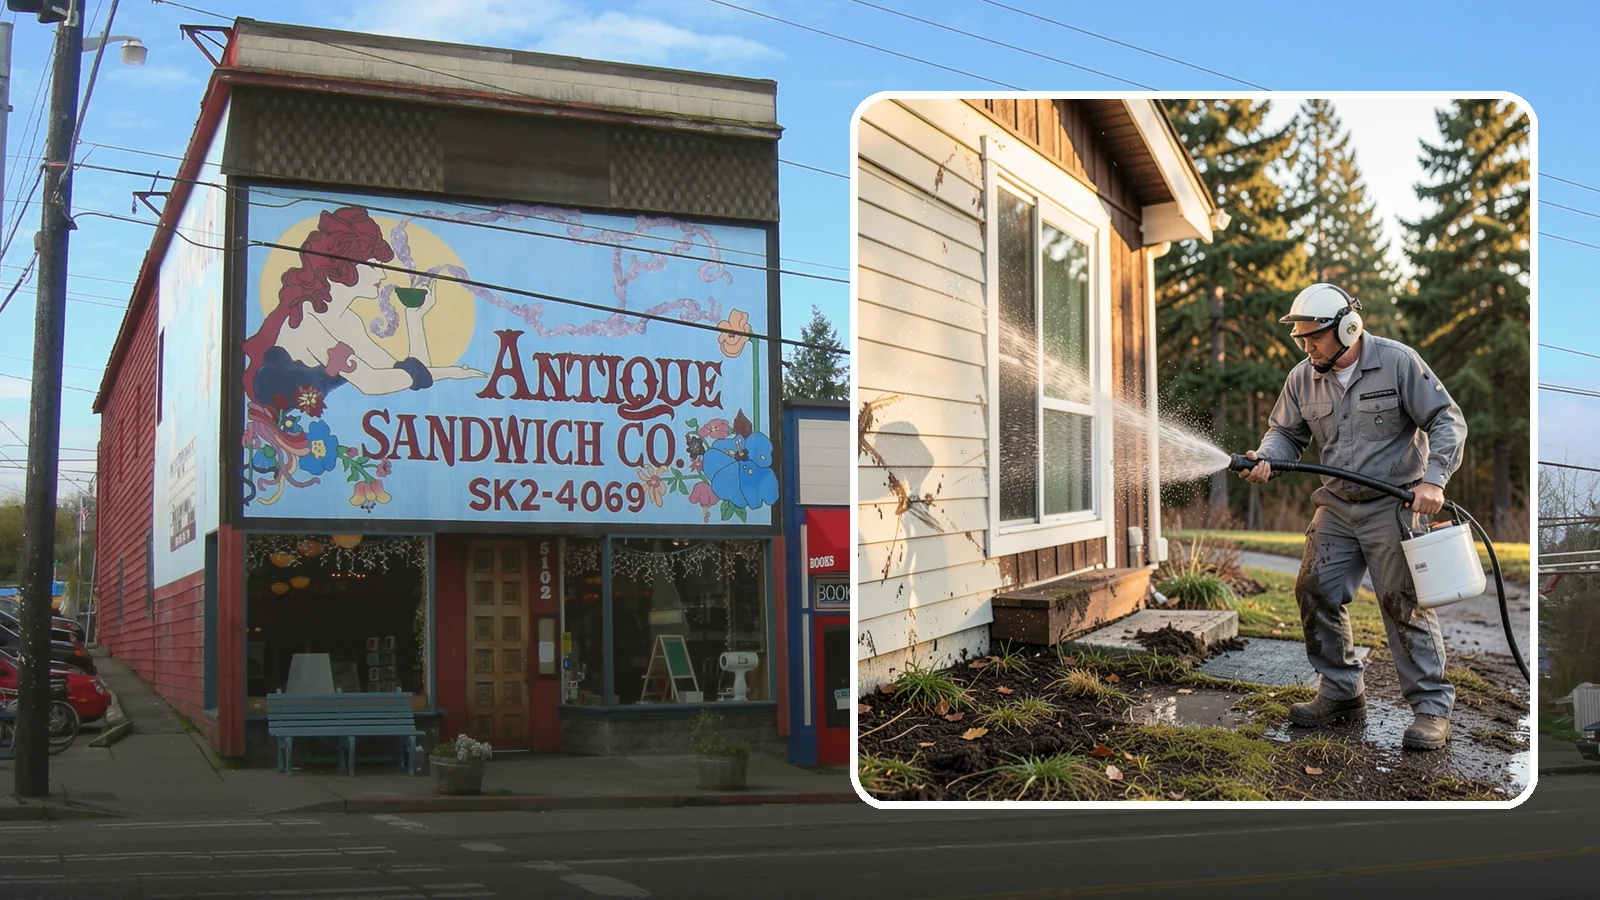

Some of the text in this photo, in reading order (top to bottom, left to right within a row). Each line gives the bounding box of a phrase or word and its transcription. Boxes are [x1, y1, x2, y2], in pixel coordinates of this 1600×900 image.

[476, 329, 723, 421] ANTIQUE
[361, 409, 685, 469] SANDWICH CO.
[468, 479, 645, 512] SK2-4069
[540, 542, 551, 599] 5102
[810, 555, 834, 568] BOOKS
